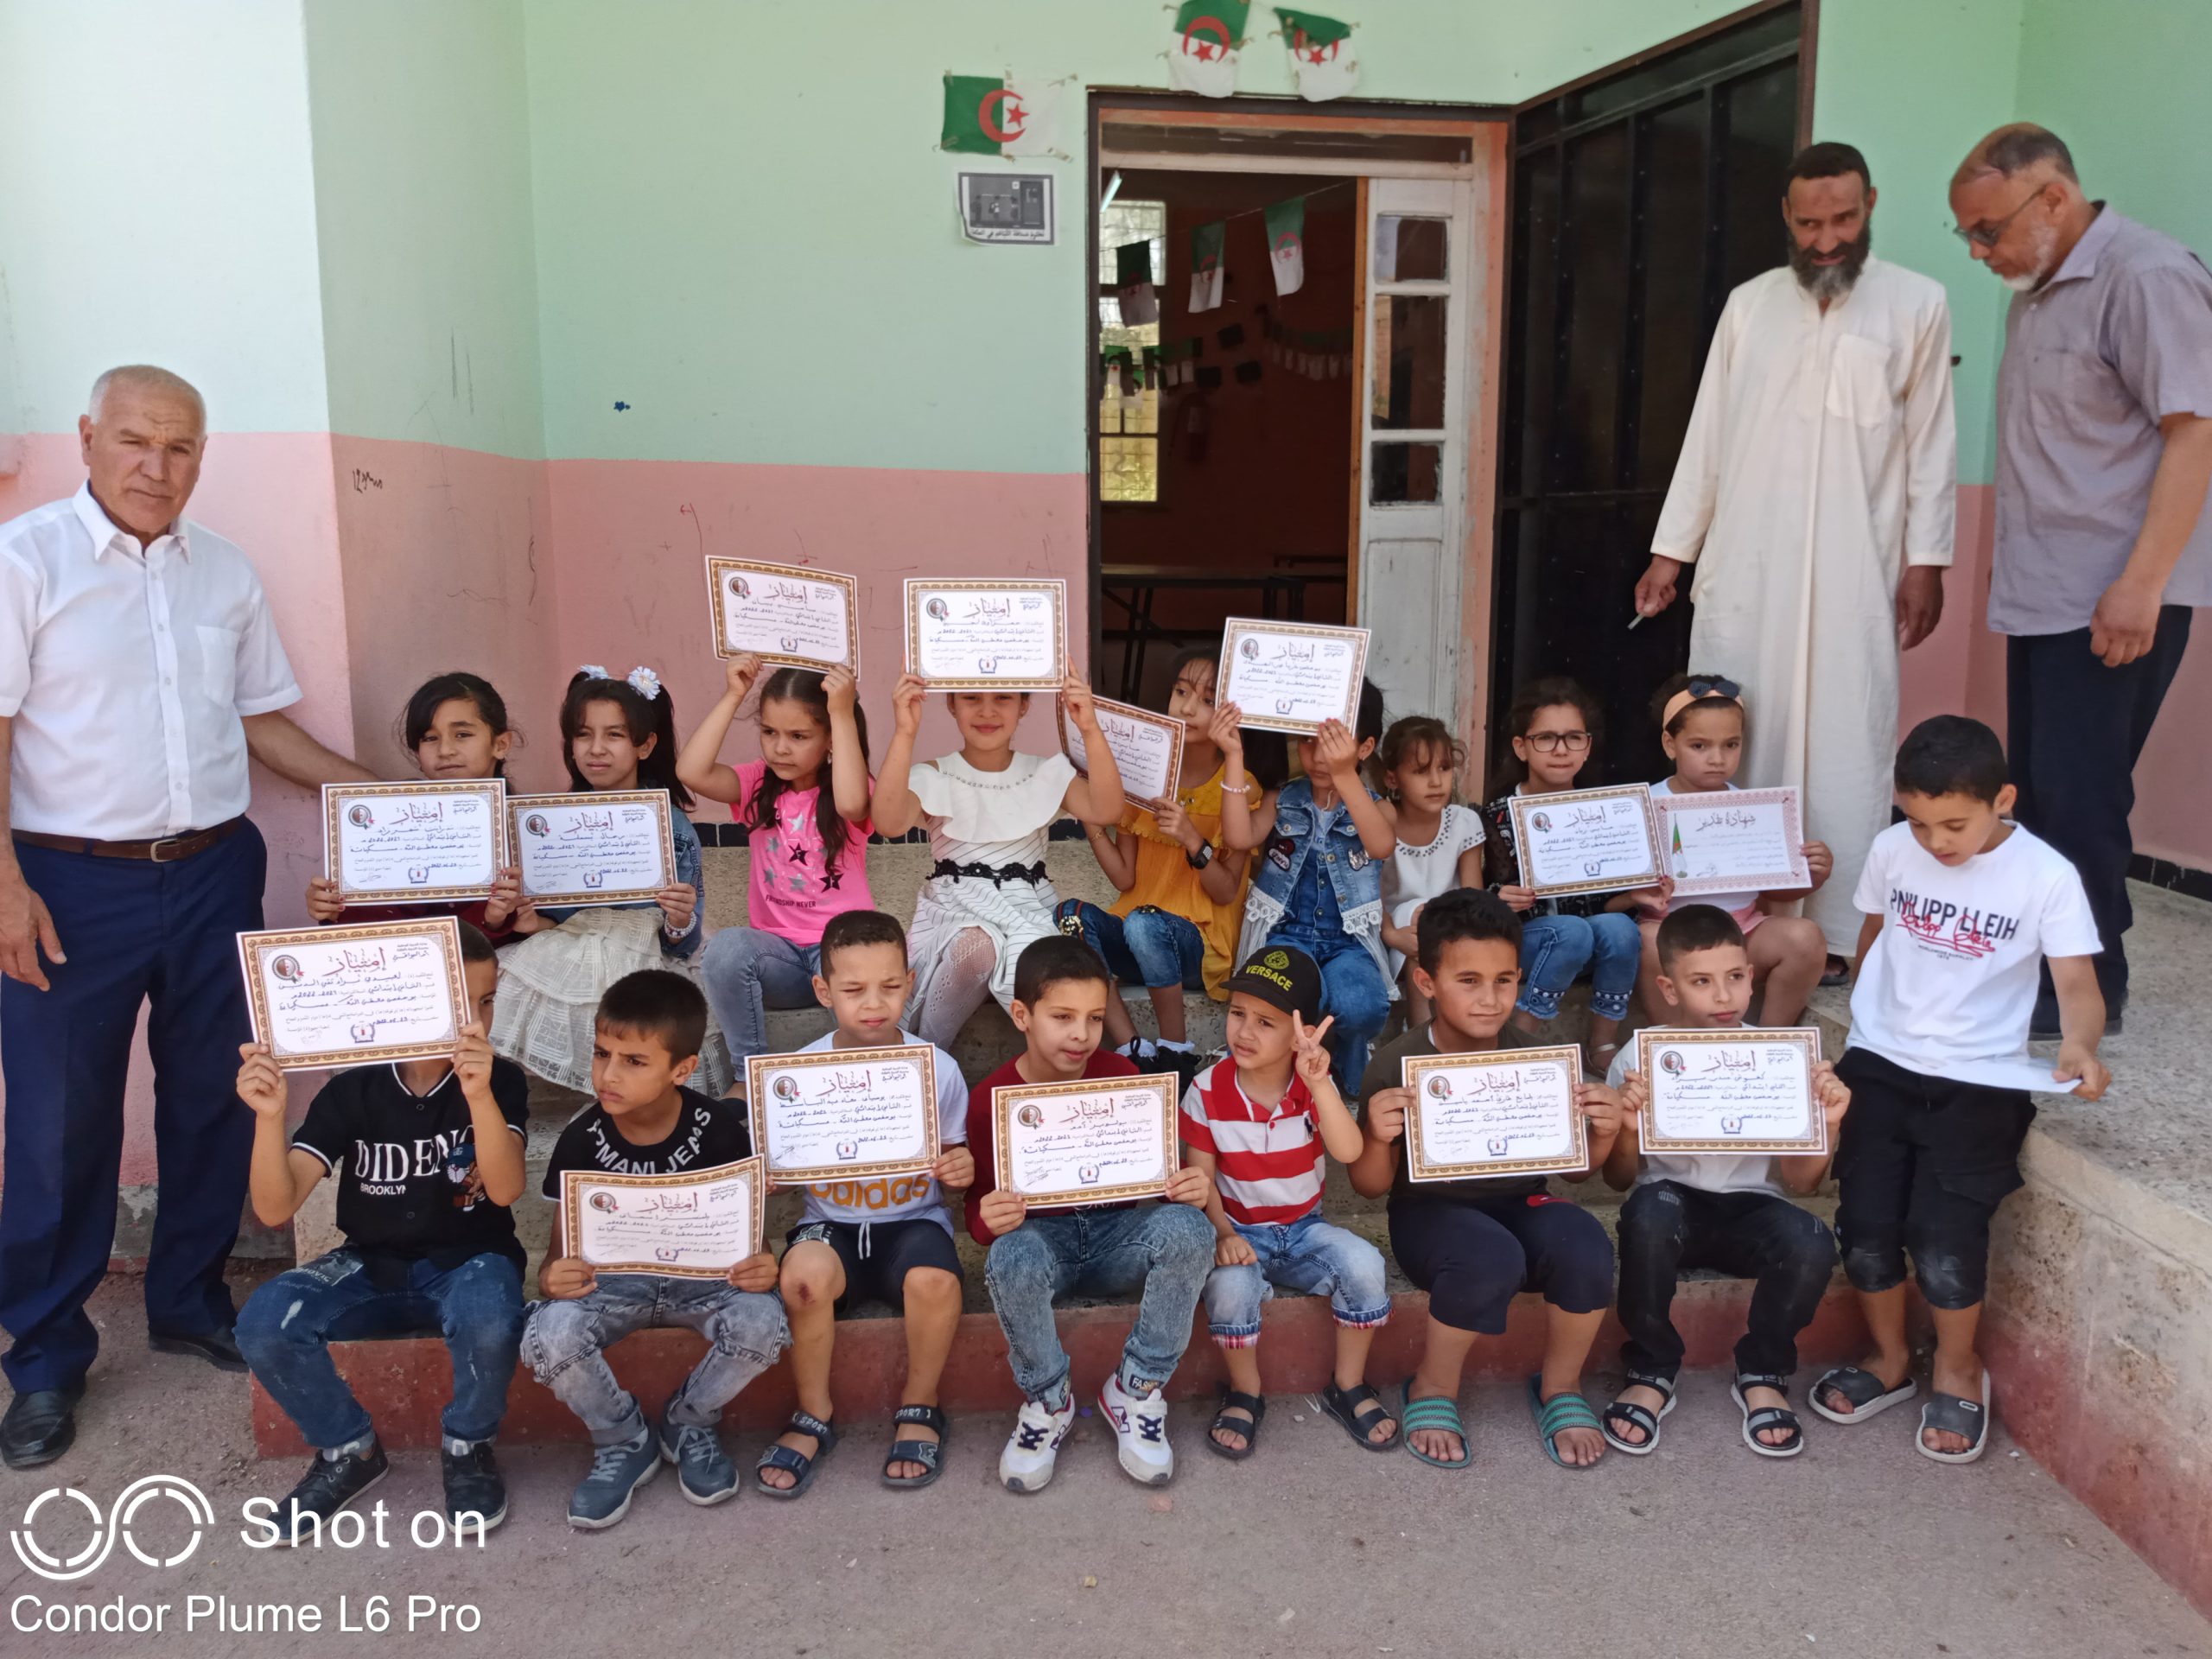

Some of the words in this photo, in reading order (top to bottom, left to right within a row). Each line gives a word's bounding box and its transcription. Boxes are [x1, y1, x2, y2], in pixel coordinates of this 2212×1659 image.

[390, 801, 442, 824] إمتياز
[563, 810, 613, 833] إمتياز
[766, 894, 795, 906] FRIDSHIP
[323, 947, 385, 976] إمتياز
[1246, 965, 1293, 992] VERSACE
[1702, 1050, 1756, 1072] إمتياز
[816, 1070, 871, 1096] إمتياز
[1468, 1070, 1520, 1095] إمتياز
[1059, 1097, 1114, 1122] إمتياز
[587, 1118, 657, 1174] MANI
[360, 1183, 406, 1195] BROOKLYN
[637, 1192, 697, 1213] إمتياز
[799, 1415, 827, 1434] SPORT
[895, 1408, 921, 1419] SPORT
